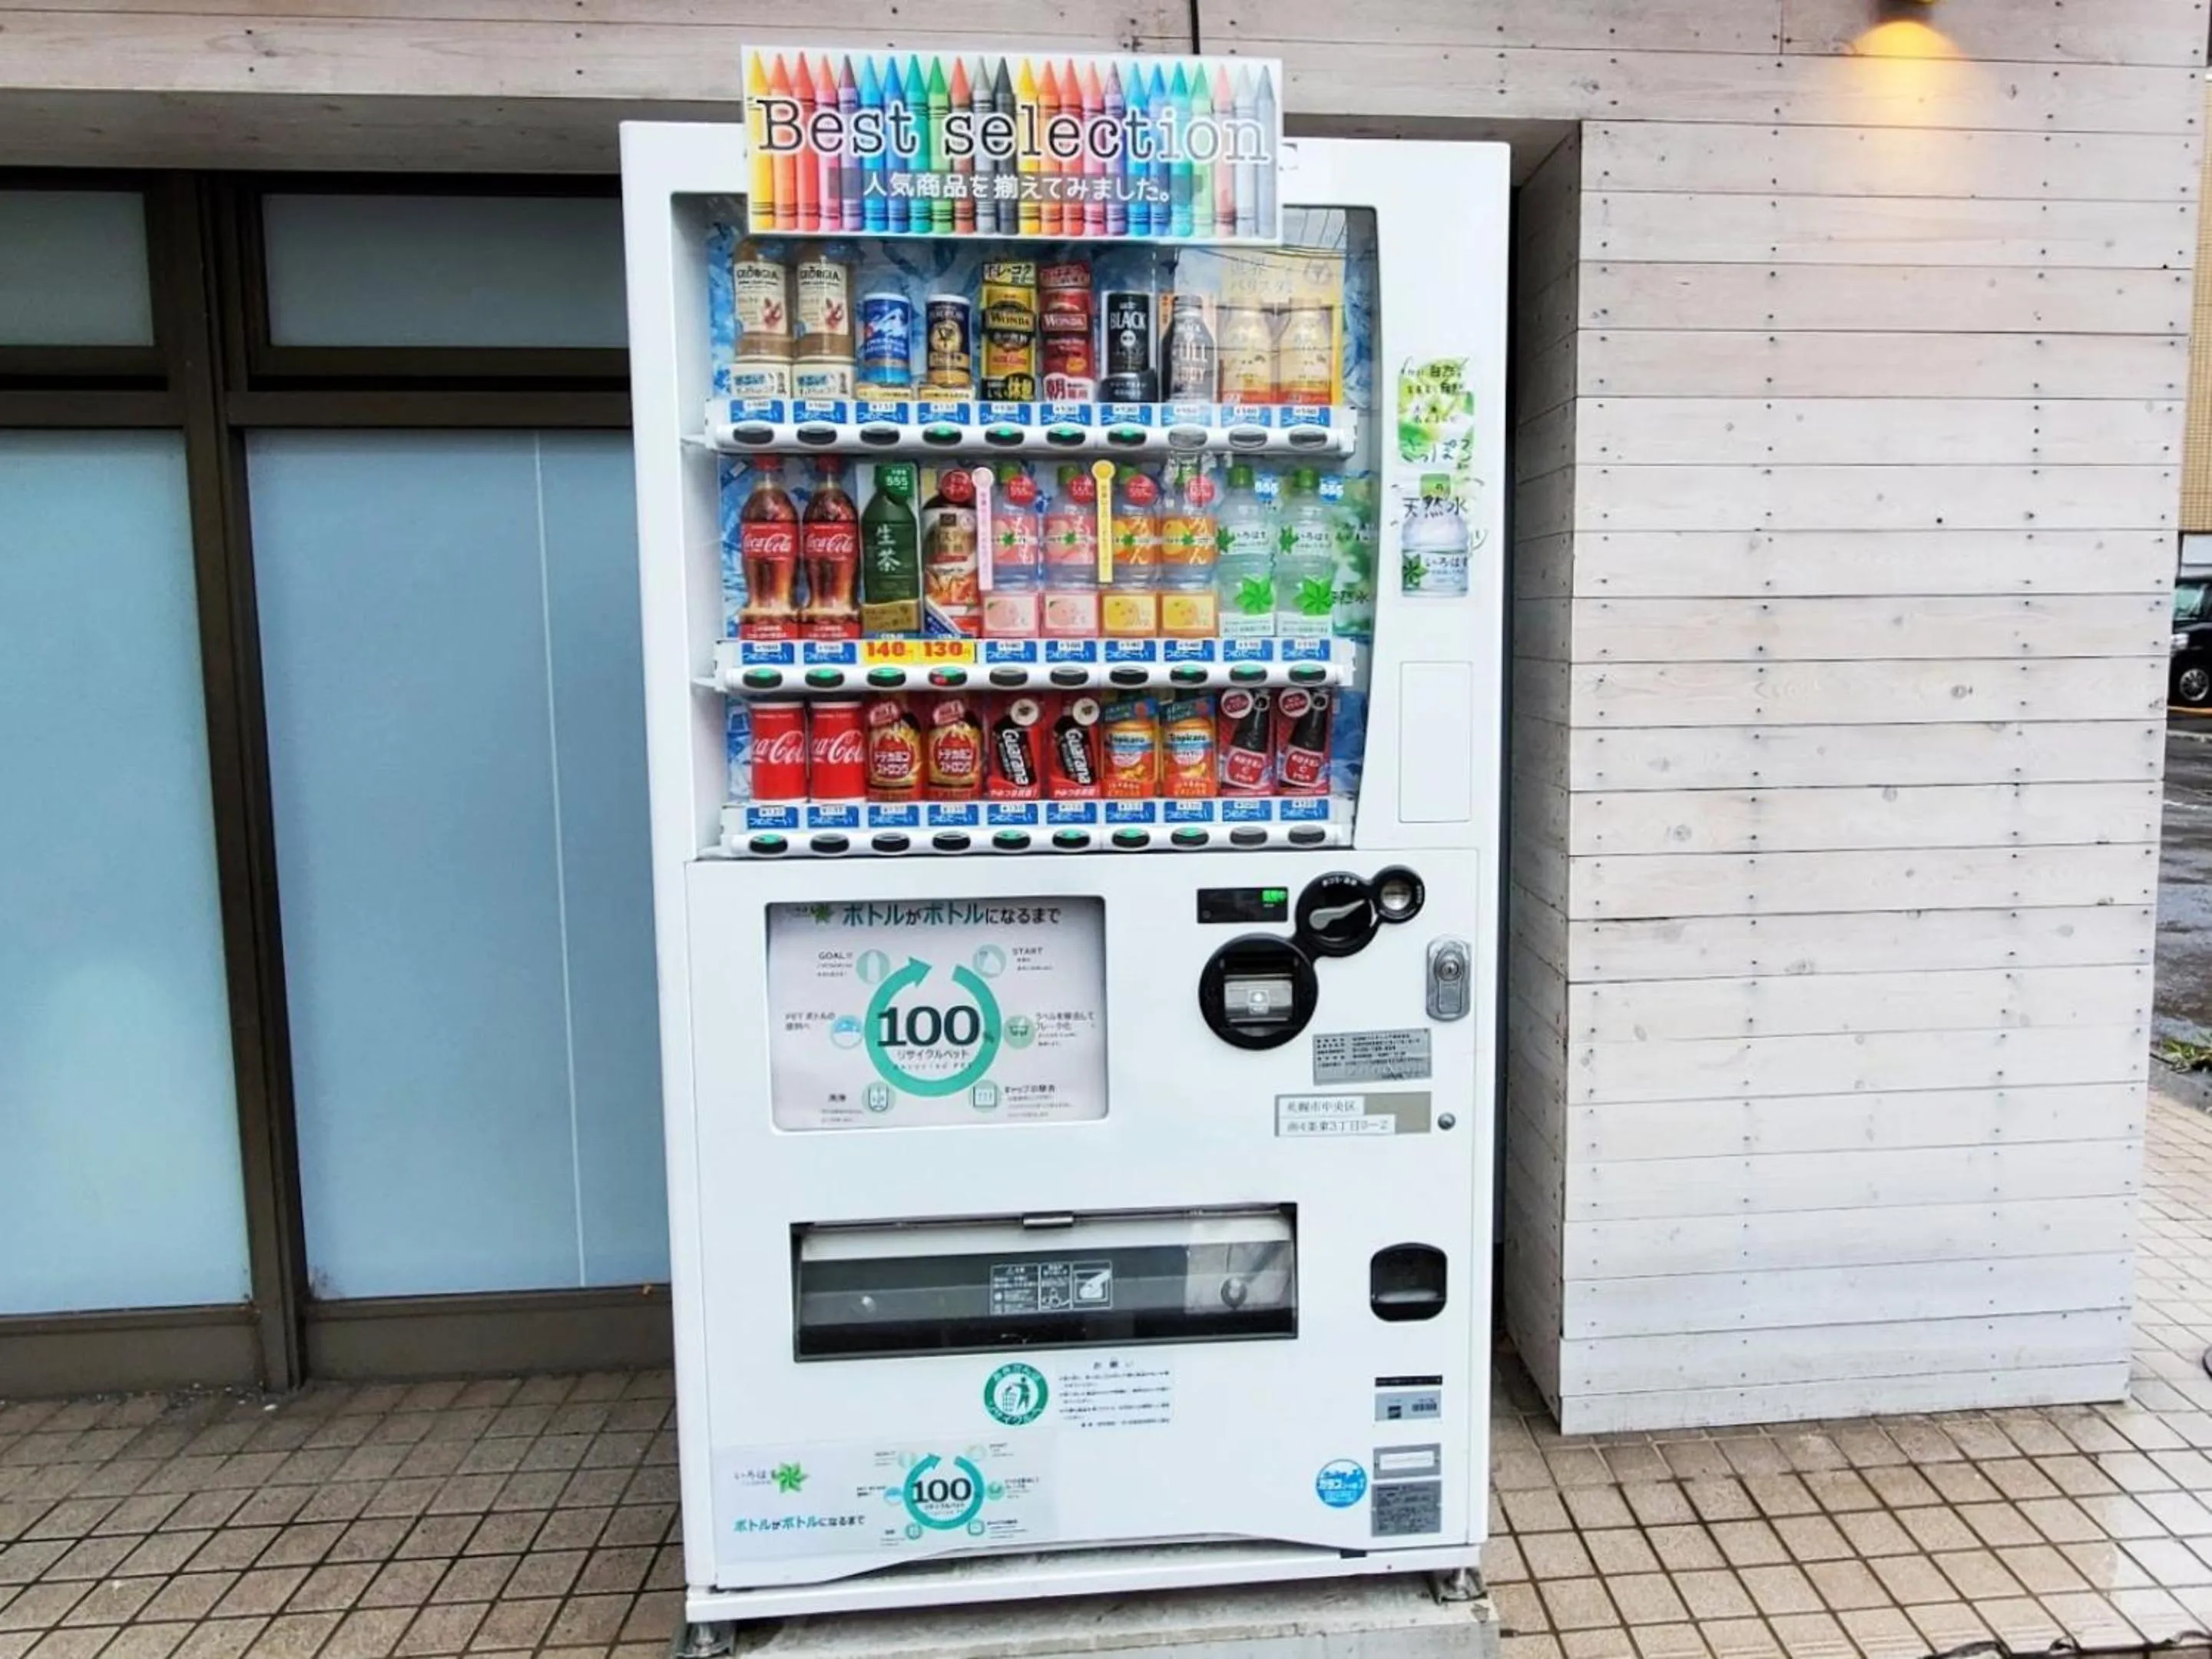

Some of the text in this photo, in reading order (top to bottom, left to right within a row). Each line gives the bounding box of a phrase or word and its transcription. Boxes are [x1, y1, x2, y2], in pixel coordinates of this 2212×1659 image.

[756, 97, 1270, 163] Best selection
[862, 172, 1171, 203] 人気商品を揃えてみました。
[1110, 311, 1146, 329] BLACK
[1402, 495, 1469, 518] 天然水
[876, 523, 901, 572] 生茶
[842, 902, 1062, 926] ボトルがボトルになるまで
[896, 1049, 971, 1060] リサイクルペット
[911, 1477, 972, 1504] 100
[733, 1514, 866, 1534] ボトルがボトルになるまで
